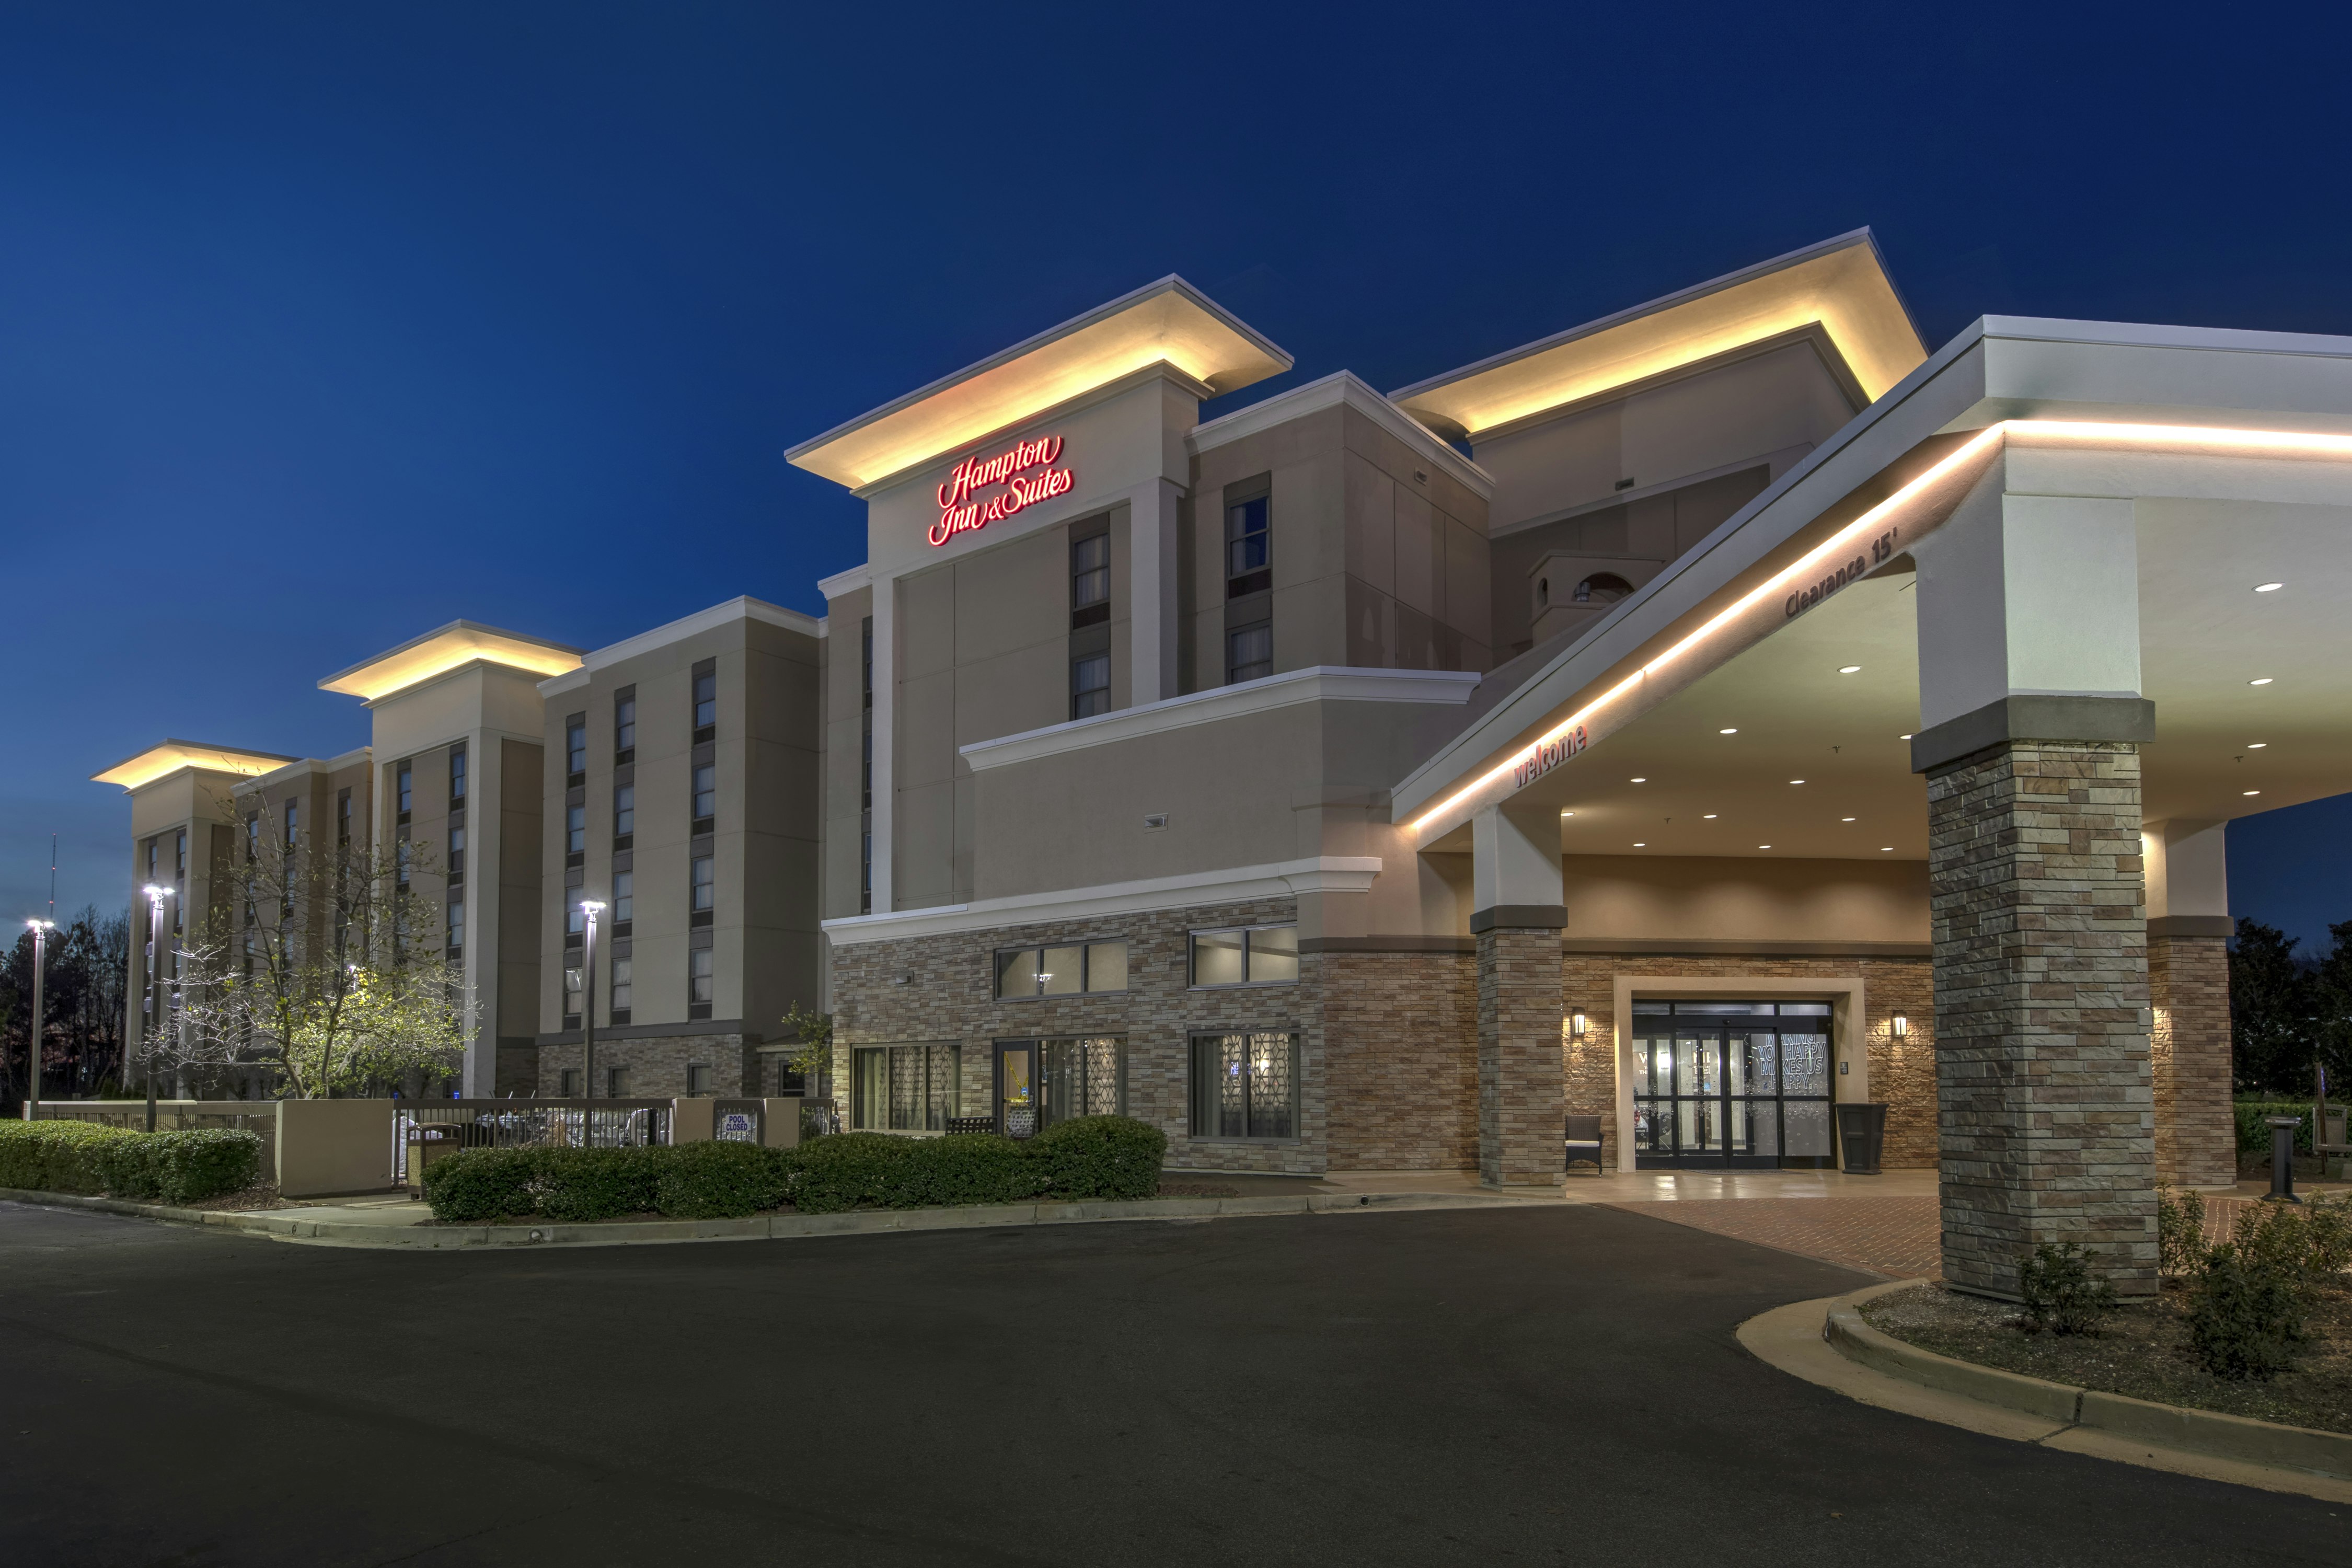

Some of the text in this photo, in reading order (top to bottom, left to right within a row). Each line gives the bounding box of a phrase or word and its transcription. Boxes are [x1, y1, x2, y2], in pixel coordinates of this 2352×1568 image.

[938, 435, 1064, 509] Hampton
[929, 468, 1075, 545] Inn & Suites
[1785, 555, 1865, 617] Clearance
[1514, 725, 1587, 788] welcome
[1758, 1042, 1826, 1061] YO HAPPY
[1806, 1057, 1823, 1074] US
